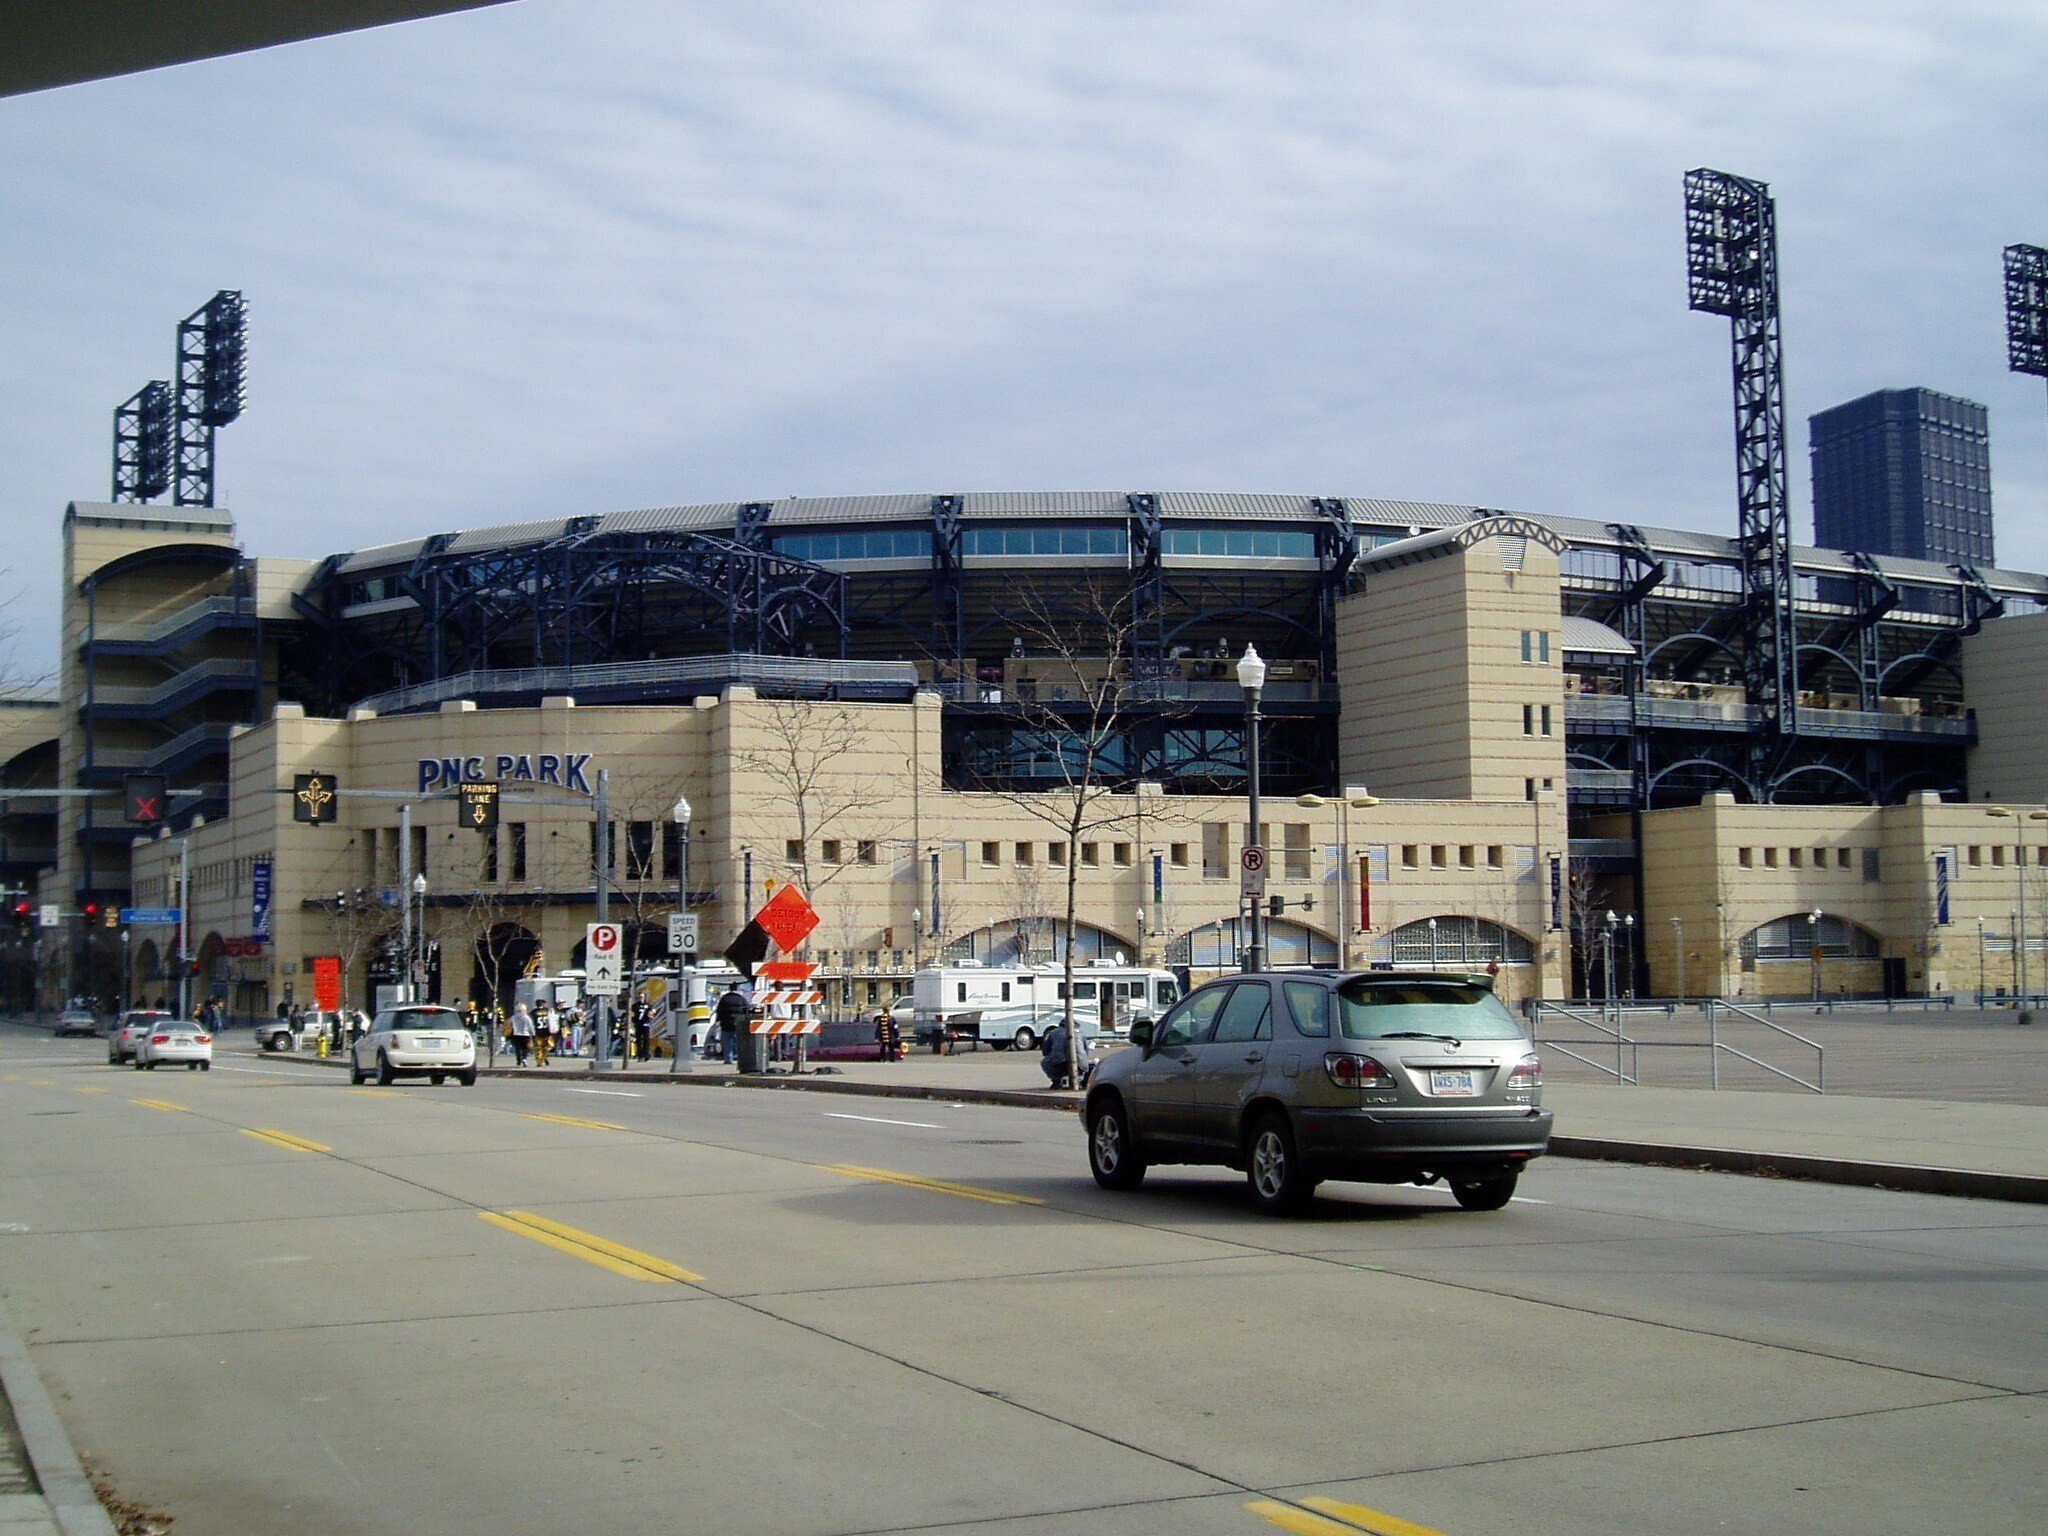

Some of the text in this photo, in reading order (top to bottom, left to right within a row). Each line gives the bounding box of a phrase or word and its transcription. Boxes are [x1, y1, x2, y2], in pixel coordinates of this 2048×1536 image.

[418, 752, 593, 796] PNC PARK
[461, 784, 497, 794] PARKING
[467, 794, 491, 804] LANE
[771, 908, 805, 919] DETOUR
[672, 917, 695, 925] SPEED
[672, 934, 695, 948] 30
[860, 965, 917, 975] SALES
